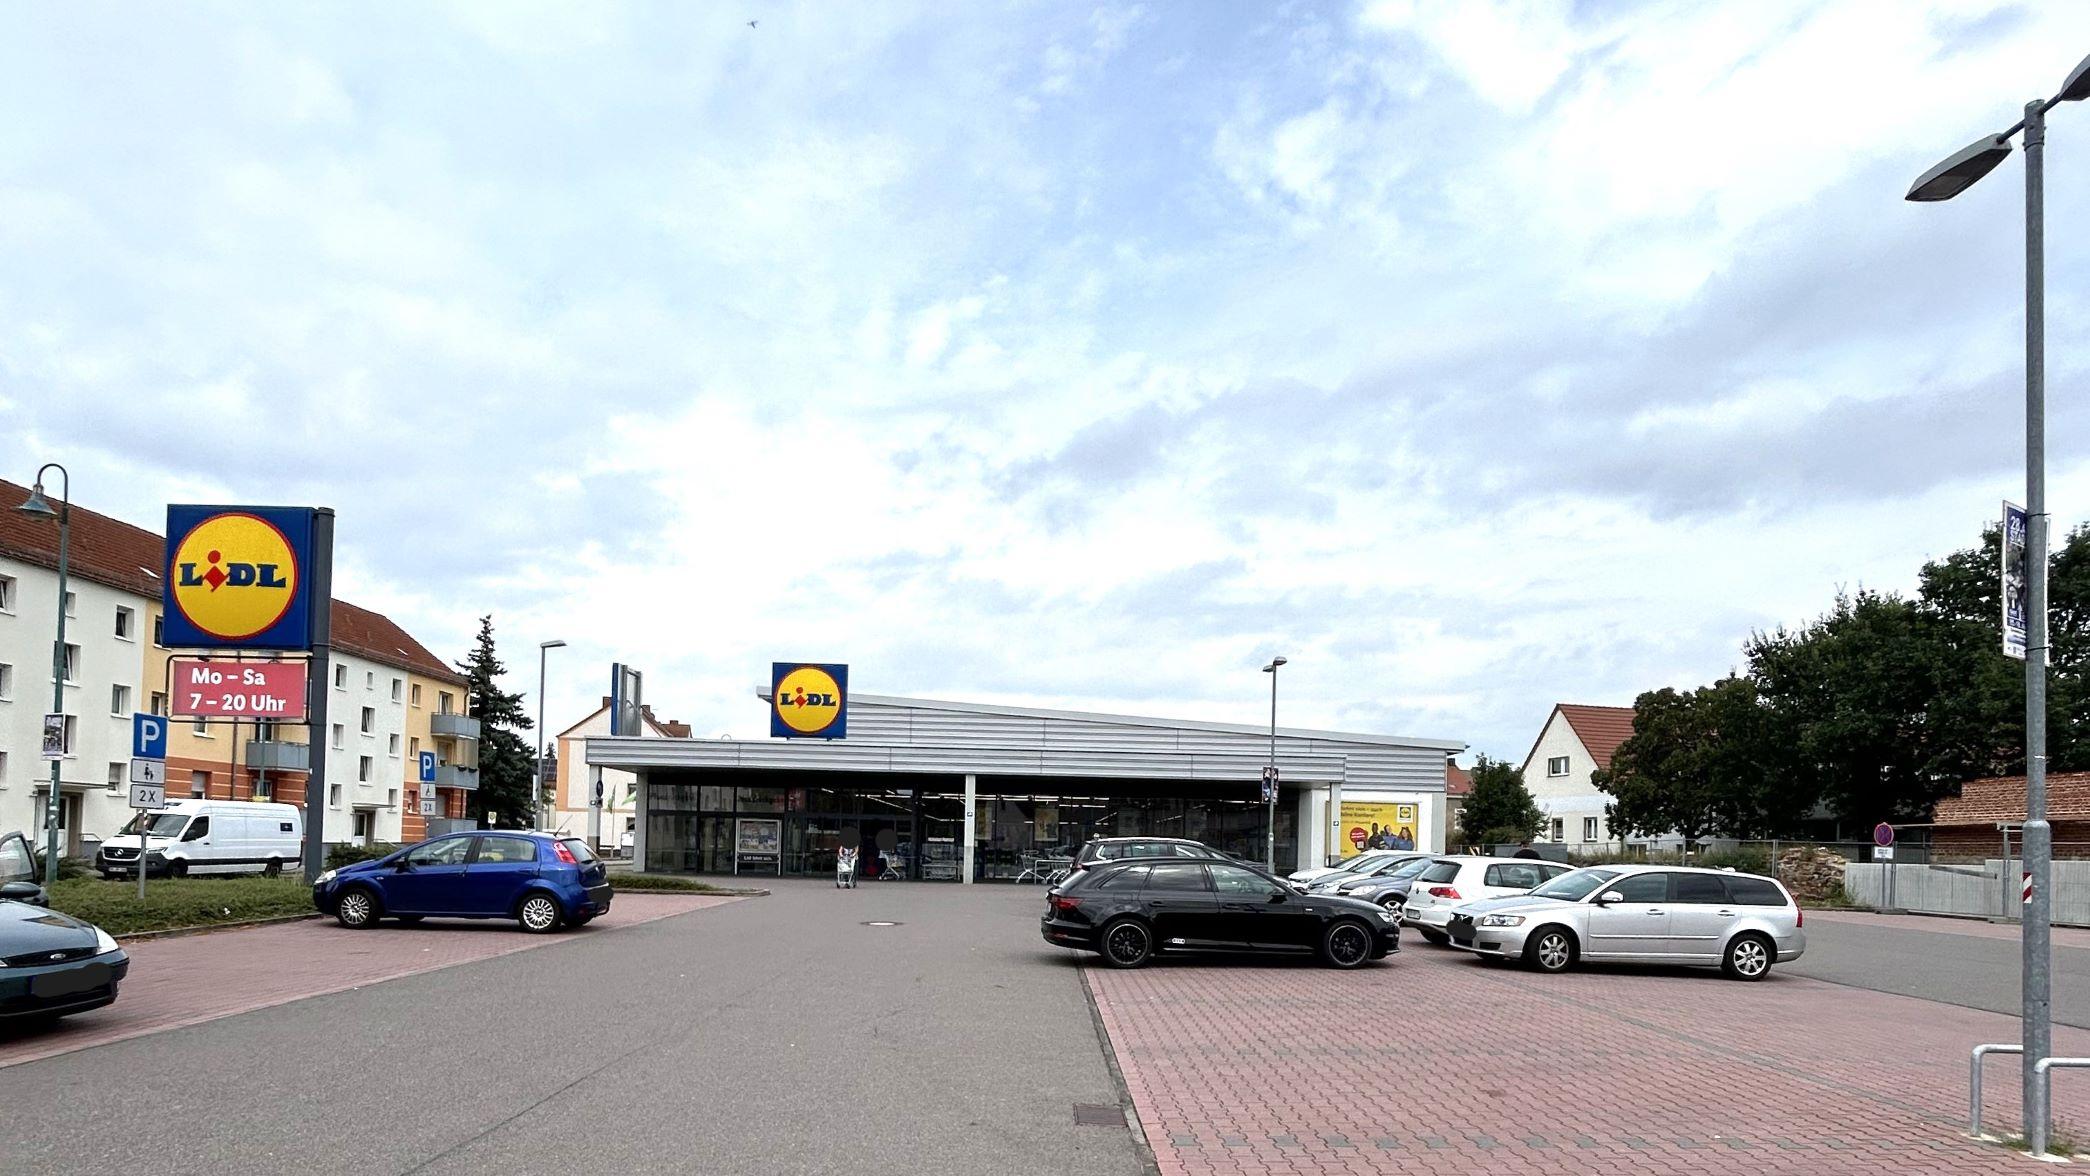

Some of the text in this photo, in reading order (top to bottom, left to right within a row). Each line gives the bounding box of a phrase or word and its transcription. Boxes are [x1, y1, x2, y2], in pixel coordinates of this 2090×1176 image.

[191, 667, 222, 684] Mo
[243, 668, 266, 685] Sa
[190, 693, 202, 710] 7
[222, 694, 246, 711] 20
[251, 694, 286, 712] Uhr
[141, 719, 160, 753] P
[423, 755, 432, 778] P
